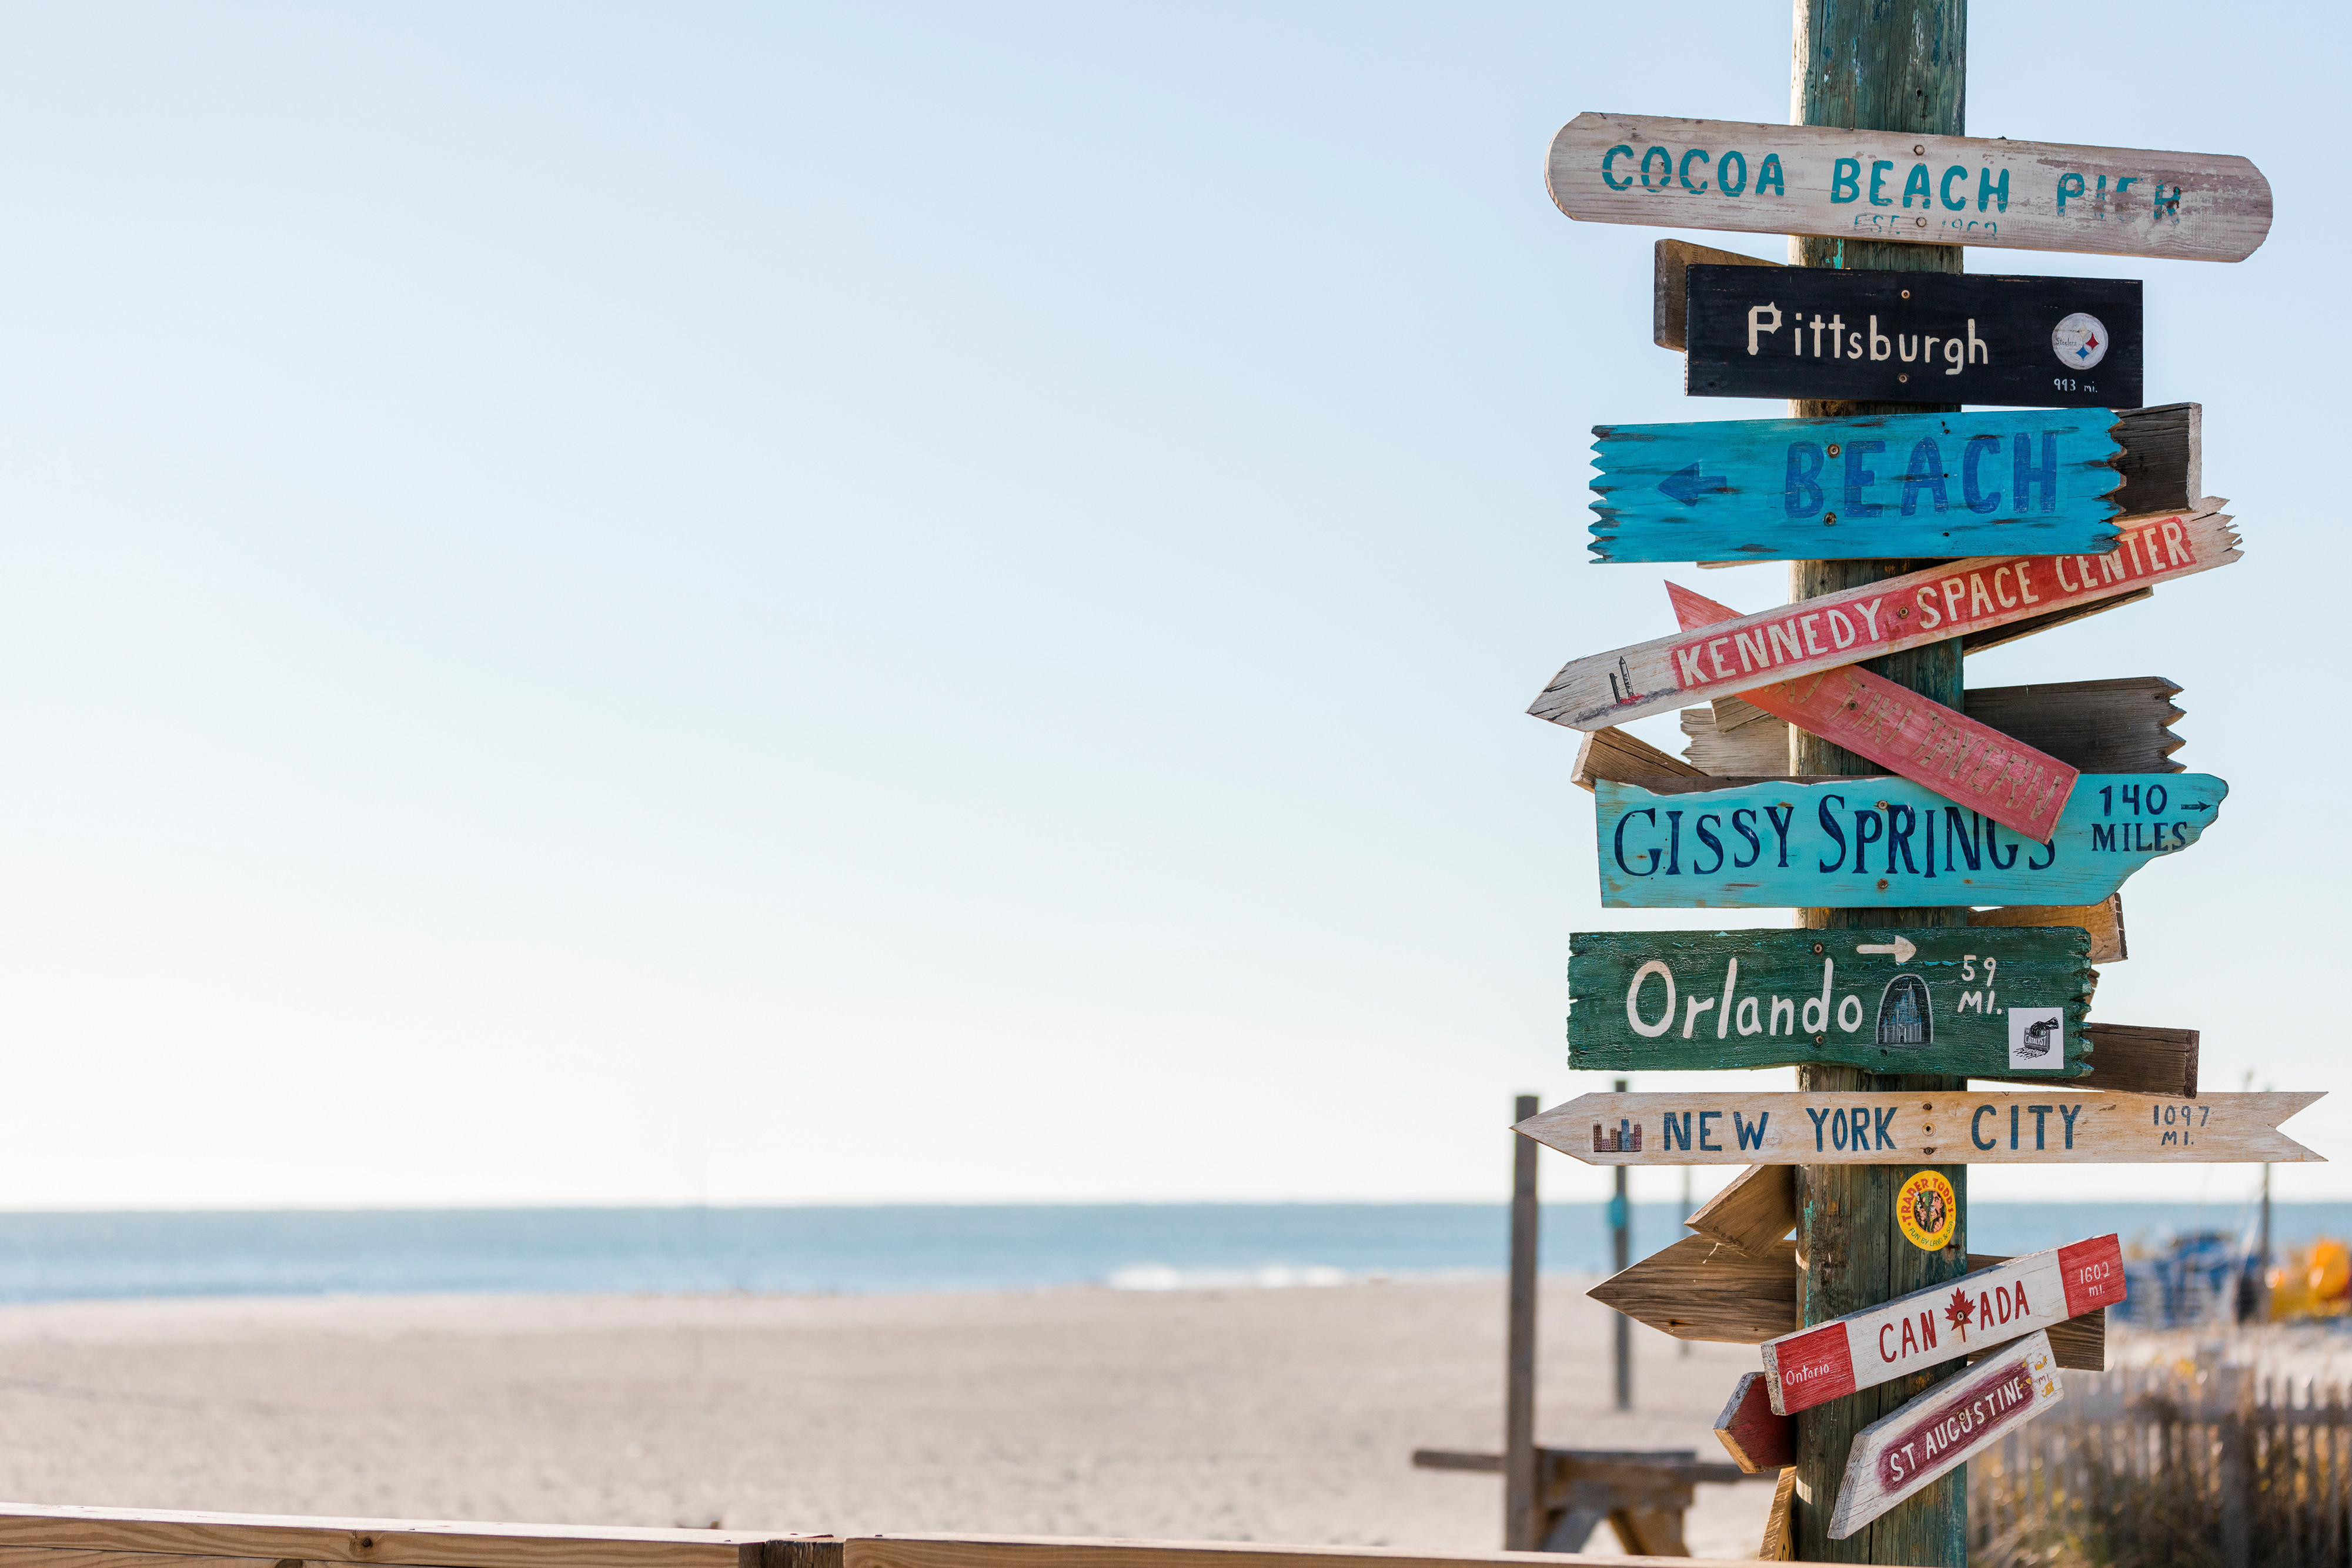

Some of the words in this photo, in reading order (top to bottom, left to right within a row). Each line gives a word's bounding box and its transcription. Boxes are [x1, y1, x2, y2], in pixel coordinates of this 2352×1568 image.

[1602, 144, 1785, 198] COCOA
[1830, 158, 2010, 213] BEACH
[1747, 301, 1989, 376] Pittsburgh
[2056, 337, 2077, 346] Steelers
[1785, 432, 2056, 519] BEACH
[1676, 597, 1882, 687] KENNEDY
[1916, 560, 2040, 630] SPACE
[2055, 521, 2192, 593] CENTER
[1828, 673, 1913, 745] TIKI
[1912, 711, 2063, 820] TAVERN
[2099, 784, 2167, 816] 140
[1614, 806, 1795, 876] GISSY
[2091, 821, 2187, 852] MILES
[1961, 954, 1997, 987] 59
[1626, 957, 1864, 1039] Orlando
[2025, 1035, 2046, 1046] CATALYST
[1663, 1111, 1769, 1151] NEW
[1805, 1107, 1898, 1152] YORK
[1971, 1104, 2082, 1151] CITY
[2153, 1105, 2210, 1128] 1097
[1900, 1178, 1929, 1223] TRADER
[1908, 1228, 1921, 1241] FUN
[1920, 1237, 1929, 1245] BY
[1929, 1237, 1943, 1247] LAND
[2080, 1261, 2110, 1285] 1602
[1786, 1363, 1830, 1386] Ontario
[1890, 1442, 1916, 1483] ST
